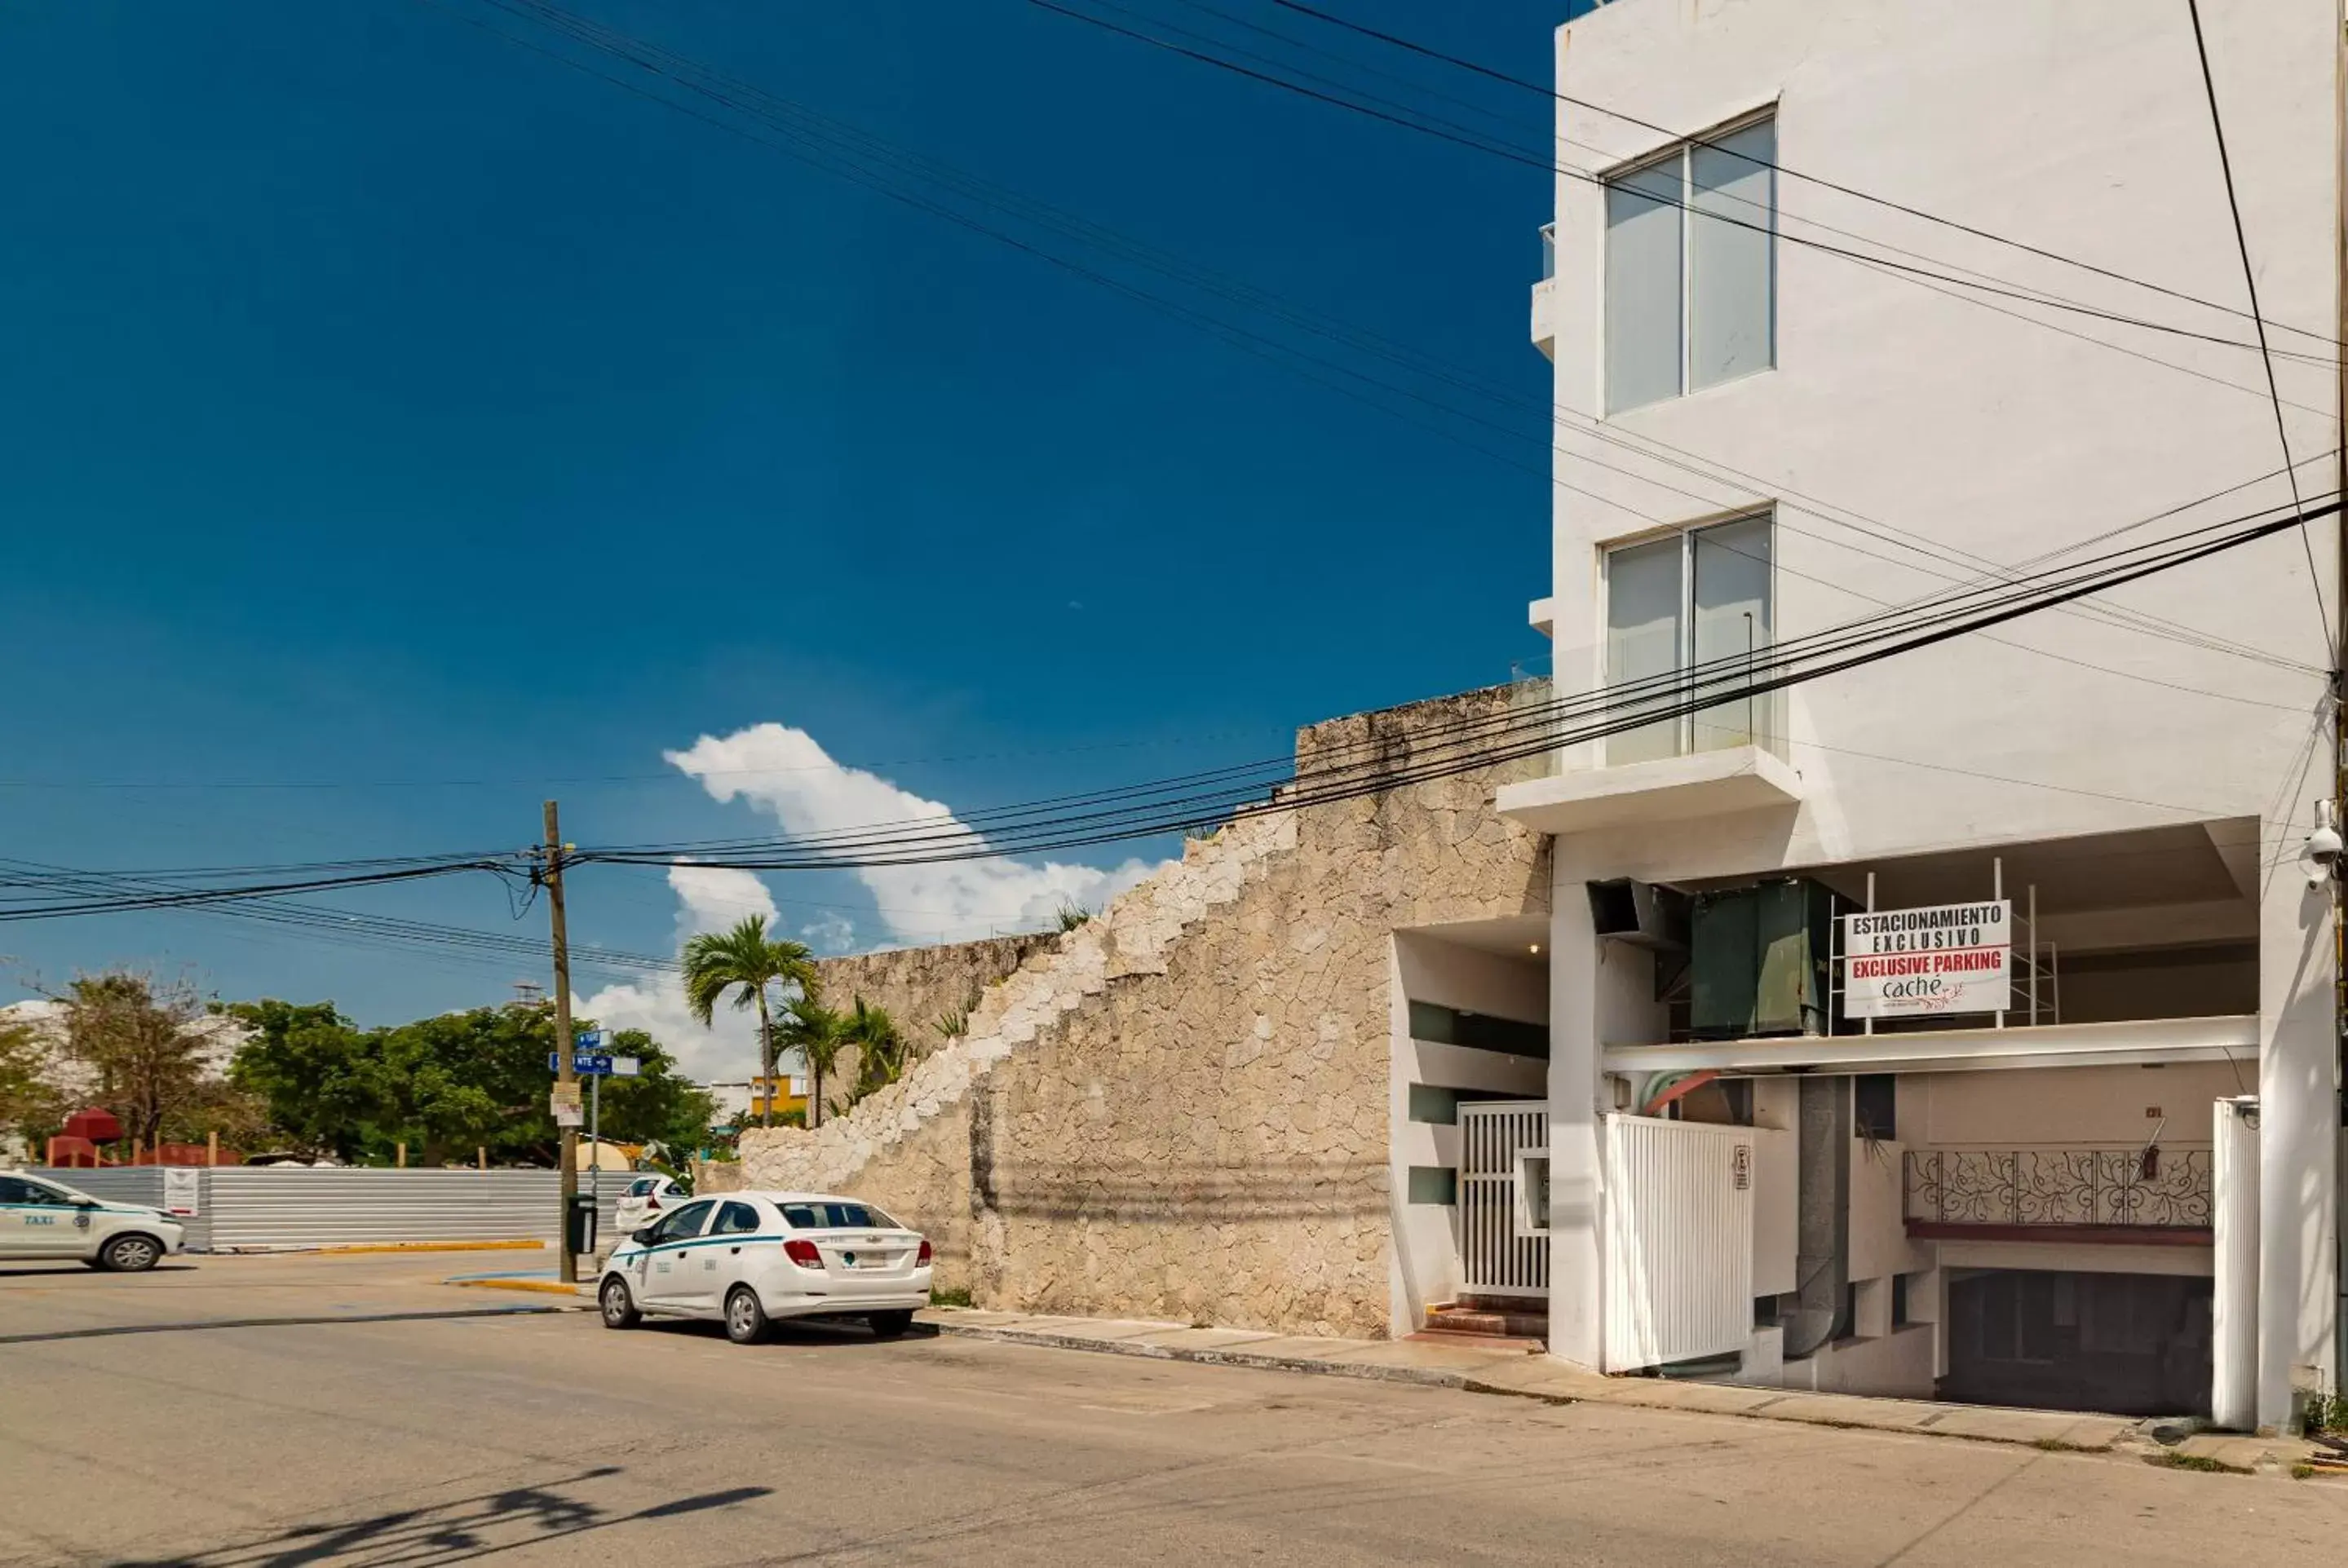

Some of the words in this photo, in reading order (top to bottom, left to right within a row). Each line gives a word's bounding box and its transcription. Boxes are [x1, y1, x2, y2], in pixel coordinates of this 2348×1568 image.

[1853, 905, 2001, 934] ESTACIONAMIENTO
[1873, 928, 1980, 952] EXCLUSIVO
[1853, 956, 1930, 978] EXCLUSIVE
[1934, 951, 2001, 973] PARKING
[1882, 974, 1942, 998] caché
[24, 1214, 56, 1226] TAXI
